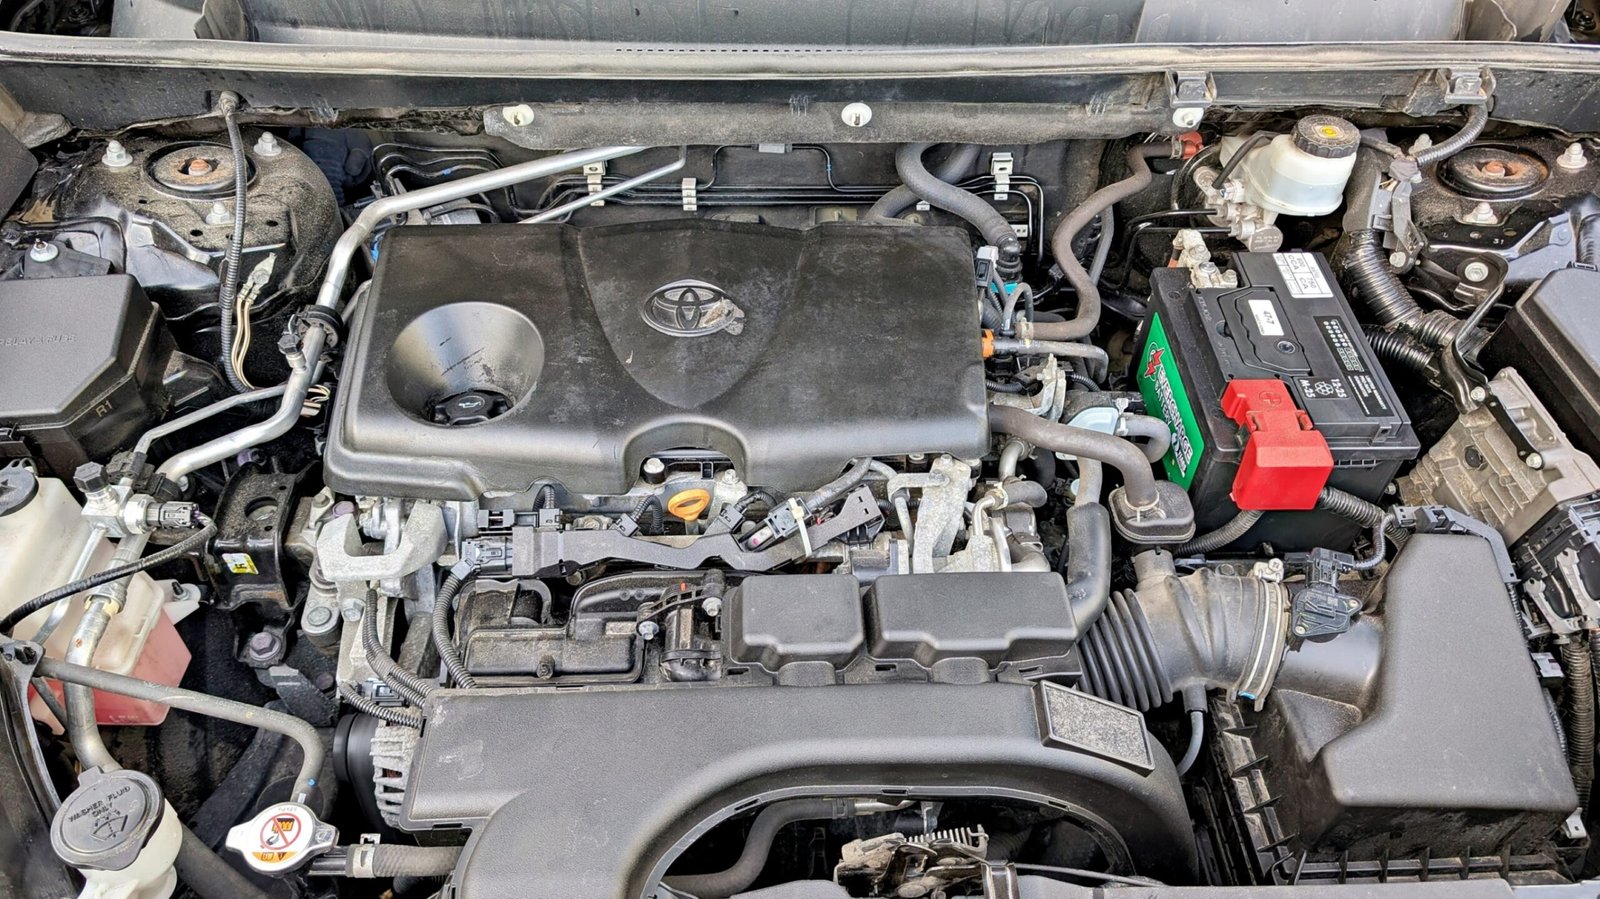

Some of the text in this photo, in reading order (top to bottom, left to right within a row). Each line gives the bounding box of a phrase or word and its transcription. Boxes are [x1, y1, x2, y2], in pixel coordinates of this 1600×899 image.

[1288, 255, 1299, 270] CCA
[1299, 277, 1309, 290] CA
[1299, 379, 1316, 398] M-25
[1331, 378, 1347, 398] 12-25
[95, 399, 114, 418] R1
[1154, 379, 1173, 426] BATTERY
[1157, 365, 1193, 466] EVERCHARGE
[68, 786, 131, 821] WASHER FLUID
[92, 803, 113, 818] ONLY
